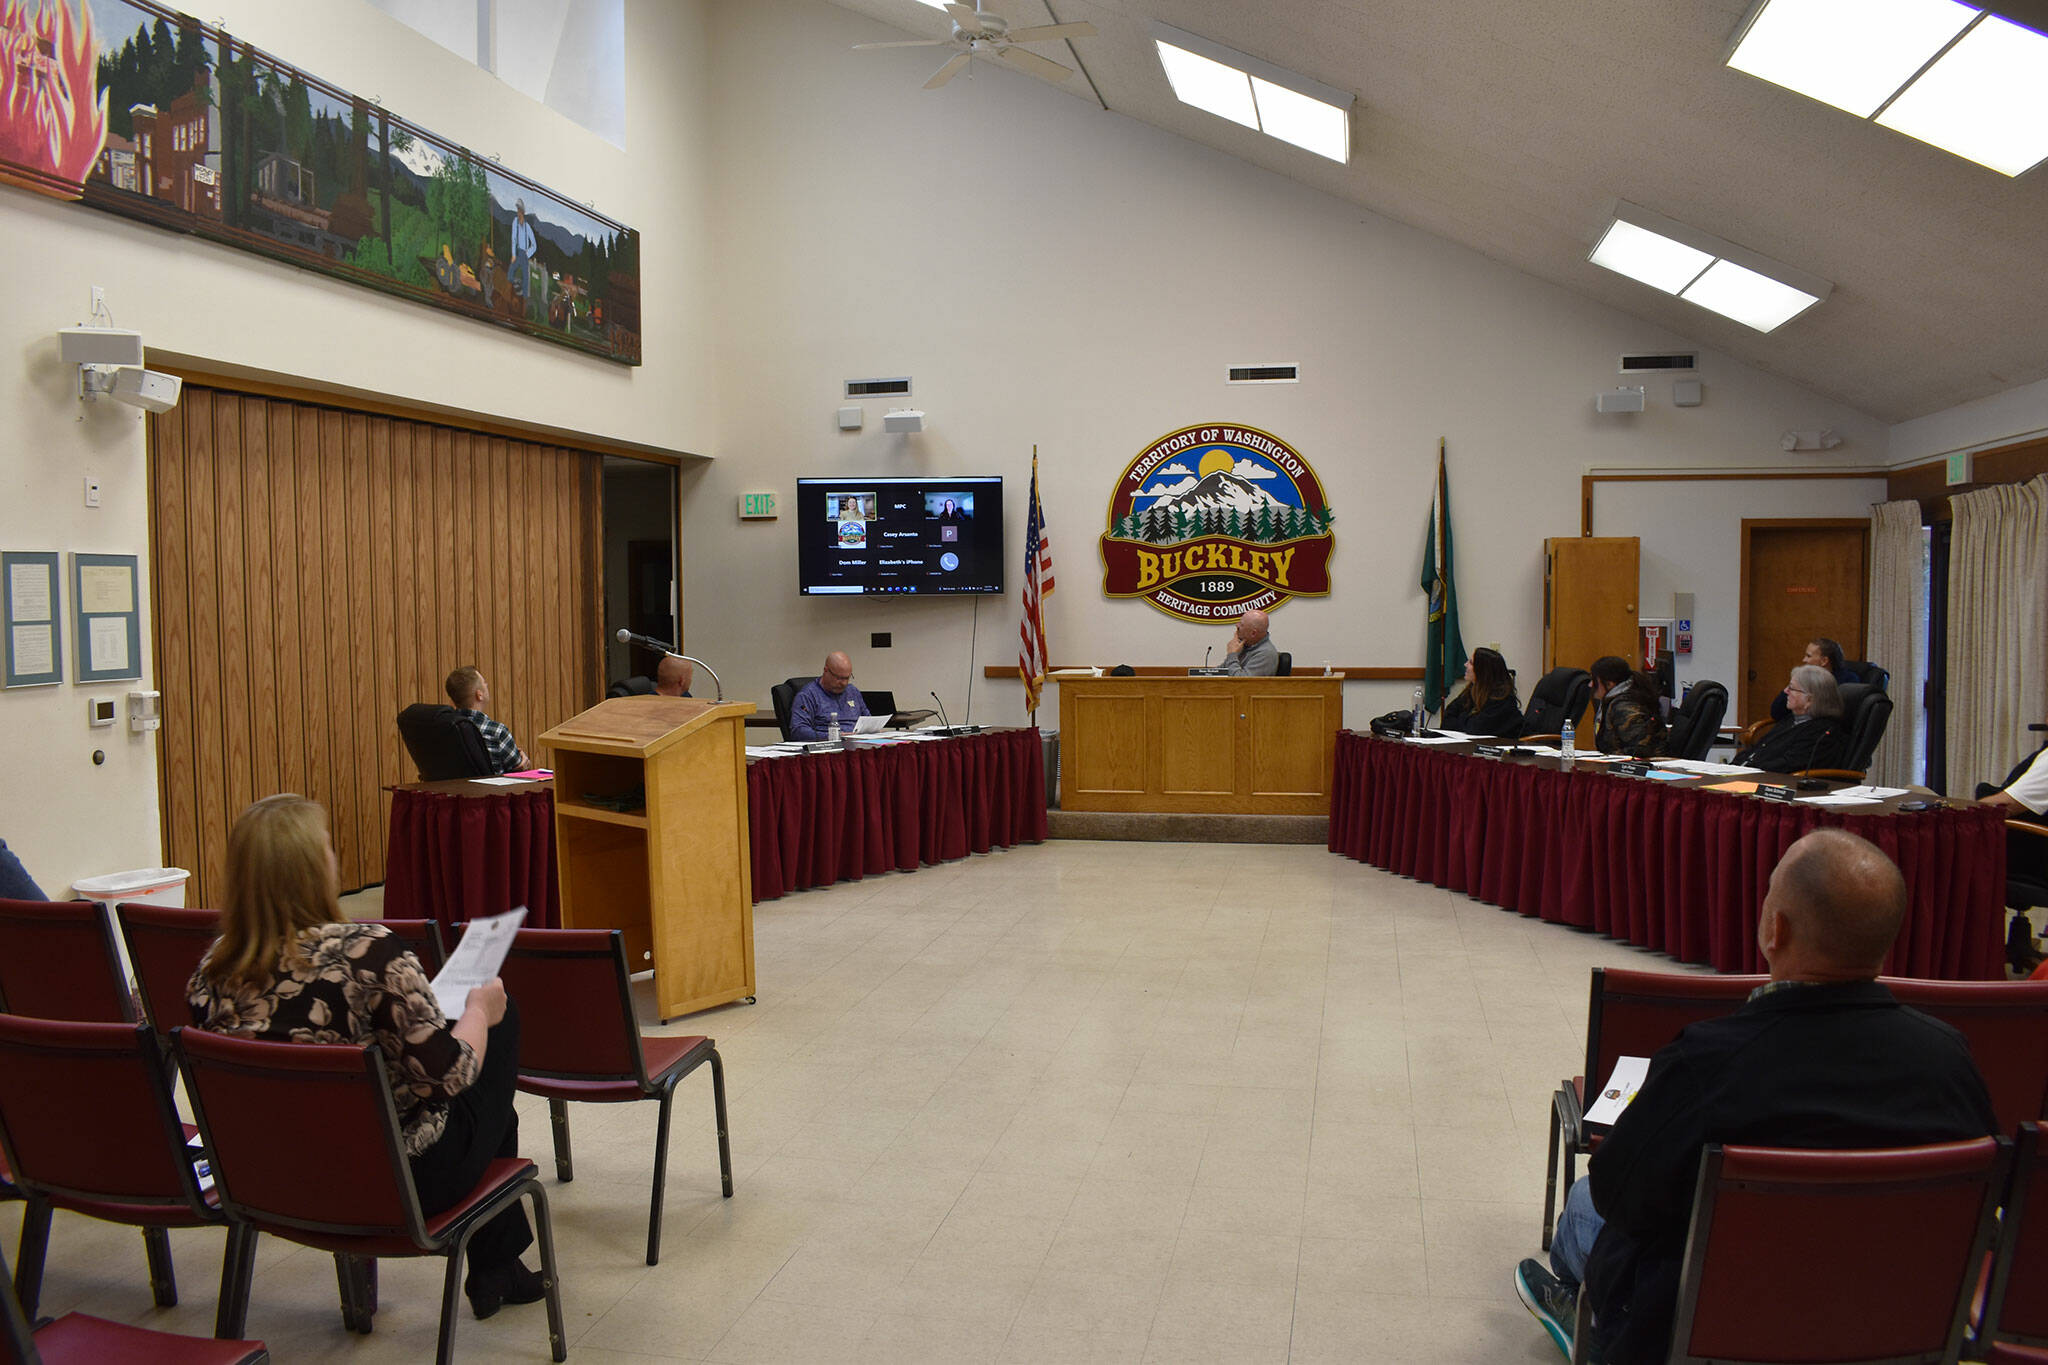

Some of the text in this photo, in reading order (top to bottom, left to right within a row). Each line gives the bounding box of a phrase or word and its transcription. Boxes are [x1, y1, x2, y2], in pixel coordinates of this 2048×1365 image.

[1129, 429, 1305, 482] TERRITORY OF WASHINGTON
[745, 494, 770, 514] EXIT
[1137, 543, 1295, 589] BUCKLEY
[1200, 581, 1235, 593] 1889
[1156, 590, 1278, 616] HERITAGE COMMUNITY
